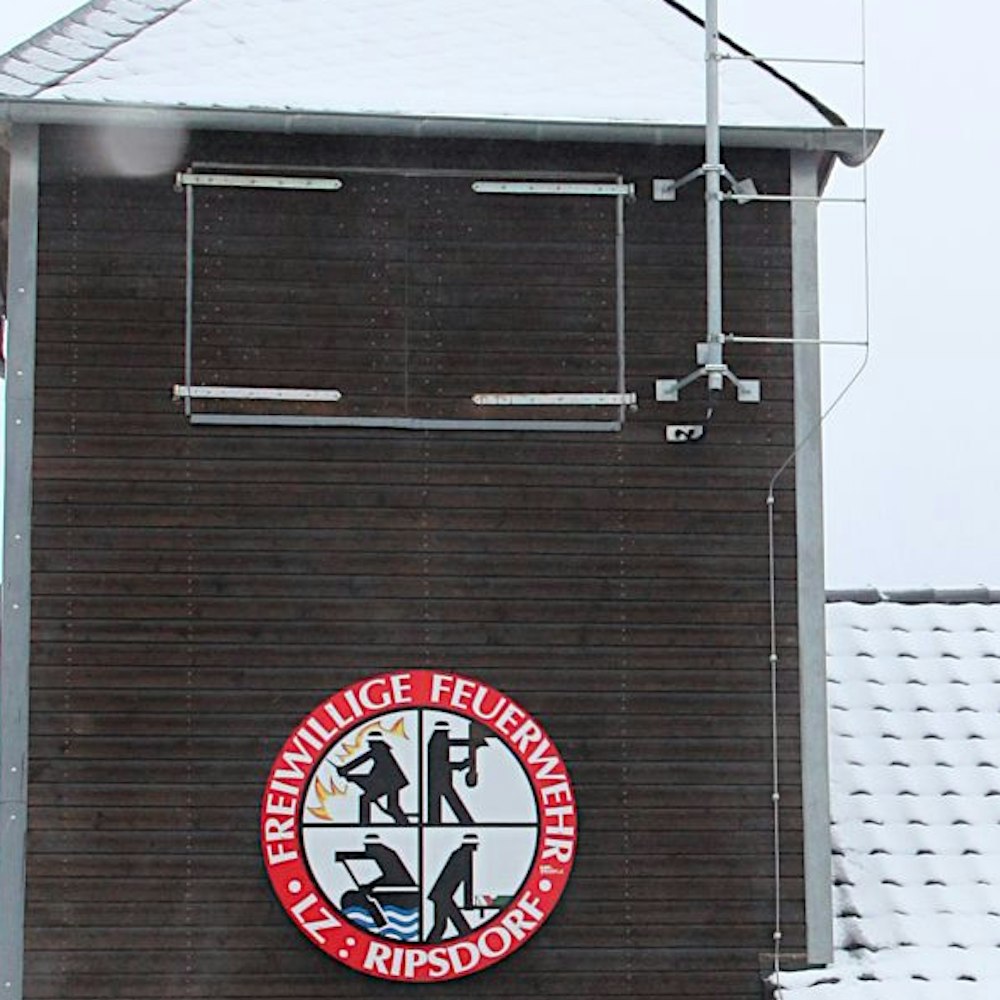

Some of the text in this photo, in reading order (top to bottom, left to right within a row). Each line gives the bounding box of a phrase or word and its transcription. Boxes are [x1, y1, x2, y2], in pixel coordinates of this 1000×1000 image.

[265, 673, 573, 865] FREIWILLIGE FEUERWEHR
[363, 891, 544, 978] RIPSDORF
